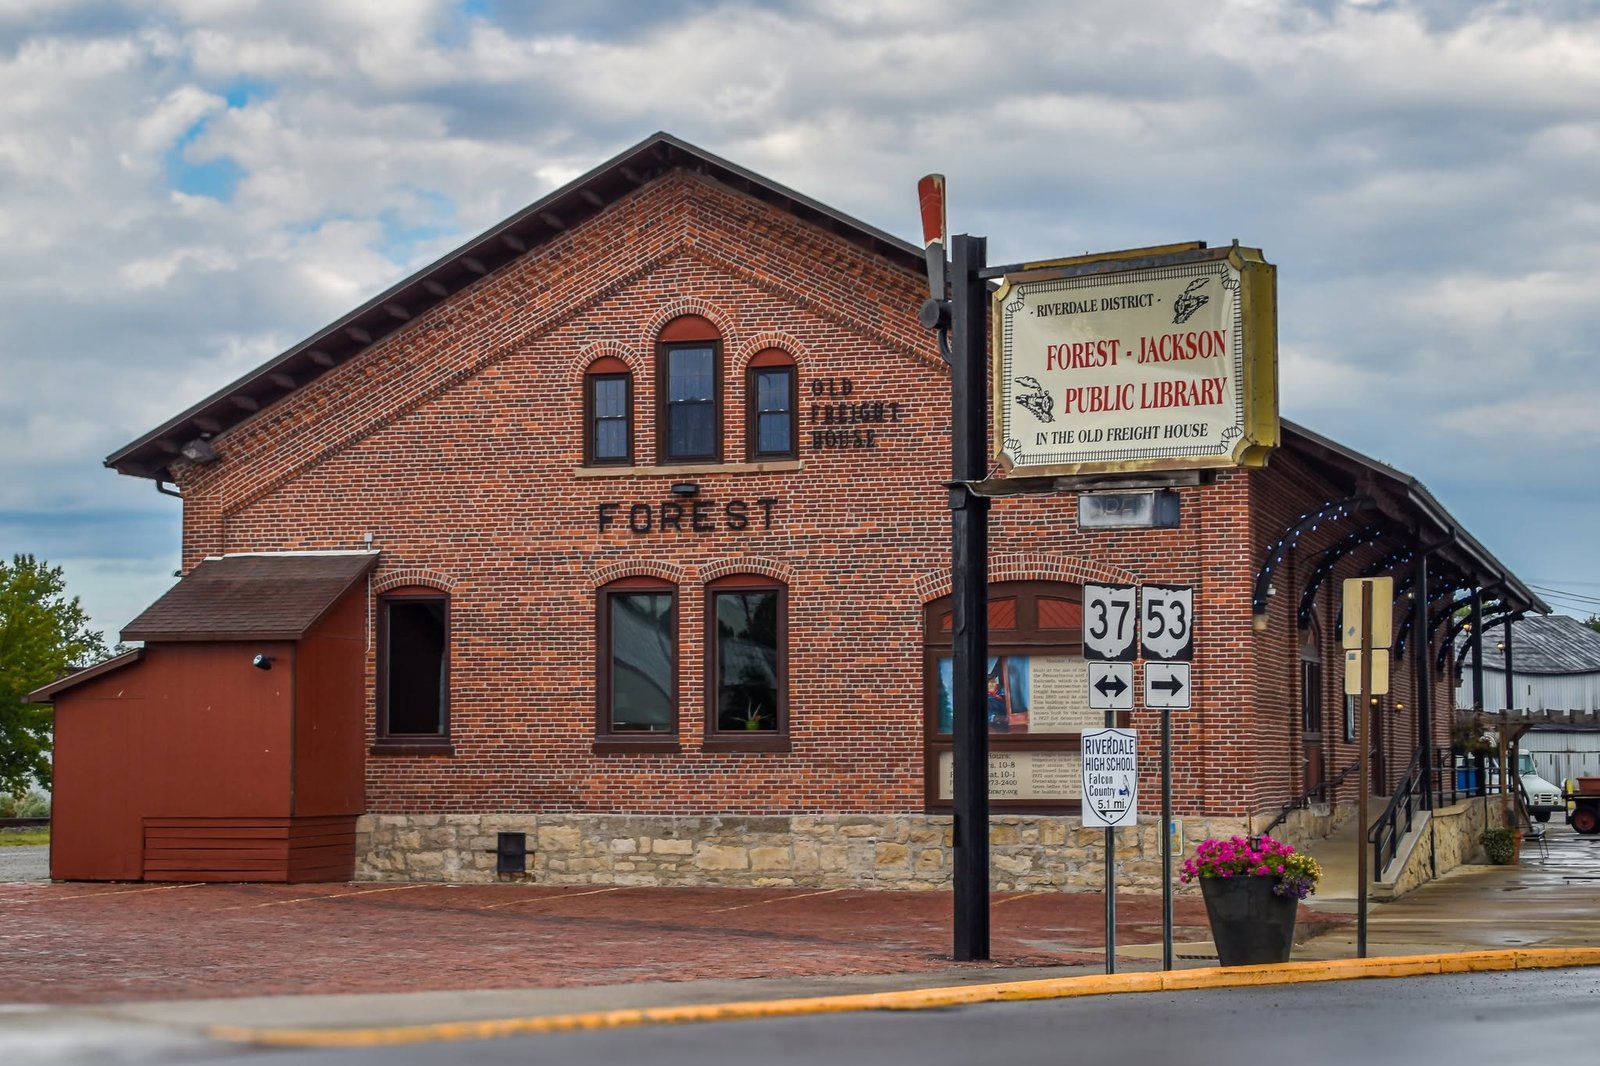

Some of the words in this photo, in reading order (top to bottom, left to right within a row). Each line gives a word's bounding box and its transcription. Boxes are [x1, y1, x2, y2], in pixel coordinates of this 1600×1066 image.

[1037, 299, 1098, 317] RIVERDALE
[1101, 293, 1154, 311] DISTRICT
[1046, 339, 1120, 371] FOREST
[1137, 329, 1227, 364] JACKSON
[811, 377, 853, 396] OLD
[1064, 382, 1135, 415] PUBLIC
[1140, 377, 1228, 409] LIBRARY
[811, 401, 899, 423] FREIGHT
[812, 429, 879, 449] HOUSE
[1035, 432, 1049, 446] IN
[1051, 430, 1075, 445] THE
[1078, 428, 1103, 443] OLD
[1106, 425, 1160, 442] FREIGHT
[1164, 423, 1209, 439] HOUSE
[599, 499, 778, 534] FOREST
[1089, 599, 1130, 640] 37
[1147, 599, 1187, 640] 53
[1085, 739, 1134, 755] RIVERDALE
[998, 761, 1016, 769] 10-8
[1085, 757, 1105, 771] HIGH
[1106, 757, 1135, 771] SCHOOL
[1089, 773, 1113, 785] Falcon
[1089, 784, 1116, 799] Country
[1097, 799, 1110, 809] 5.1
[1113, 798, 1127, 809] mi.
